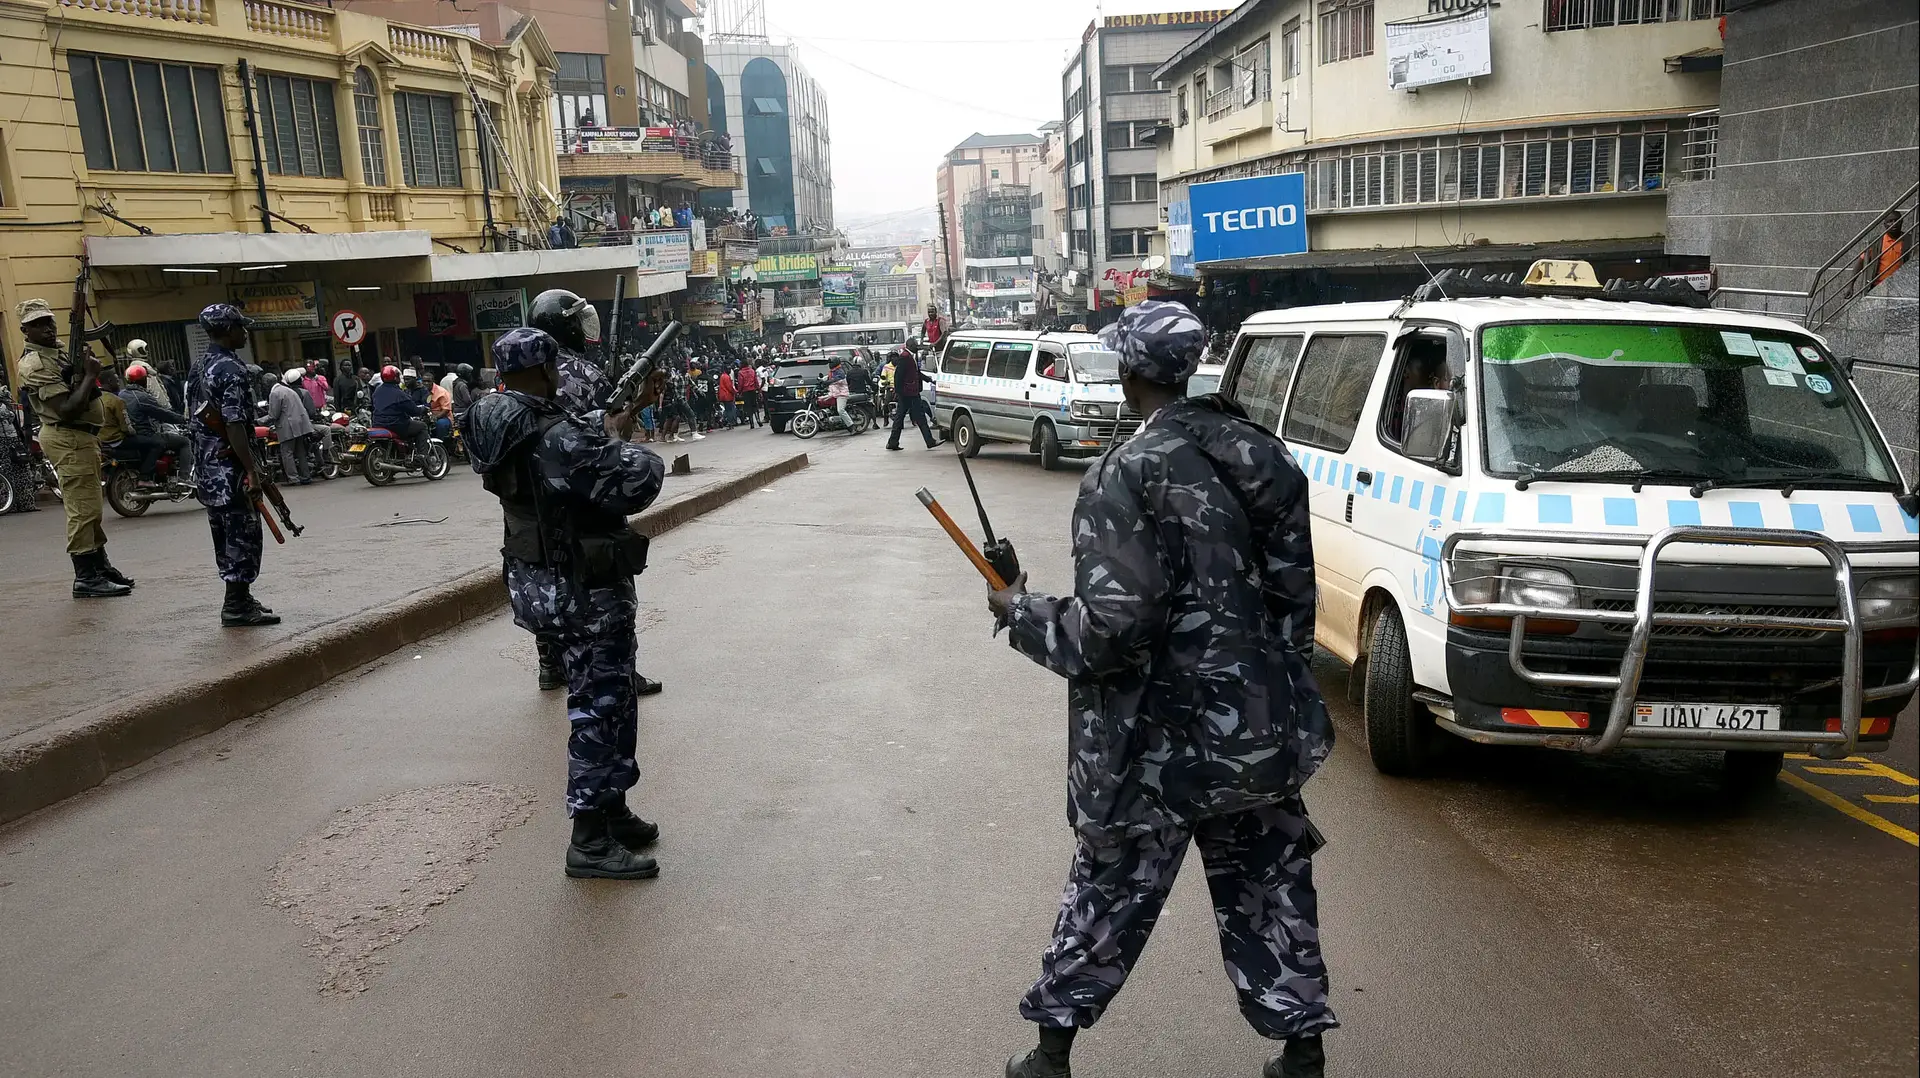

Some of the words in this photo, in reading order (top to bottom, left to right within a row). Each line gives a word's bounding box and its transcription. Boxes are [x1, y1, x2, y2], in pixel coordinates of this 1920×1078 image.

[1104, 14, 1161, 27] HOLIDAY
[1203, 204, 1297, 233] TECNO
[645, 235, 664, 244] BIBLE
[665, 234, 687, 243] WORLD
[778, 253, 816, 271] Bridals
[845, 252, 861, 260] ALL
[861, 252, 871, 260] 64
[870, 252, 896, 260] matches
[342, 318, 356, 338] P
[1809, 380, 1830, 393] PSV
[1663, 707, 1702, 728] UAV
[1716, 708, 1769, 731] 462T
